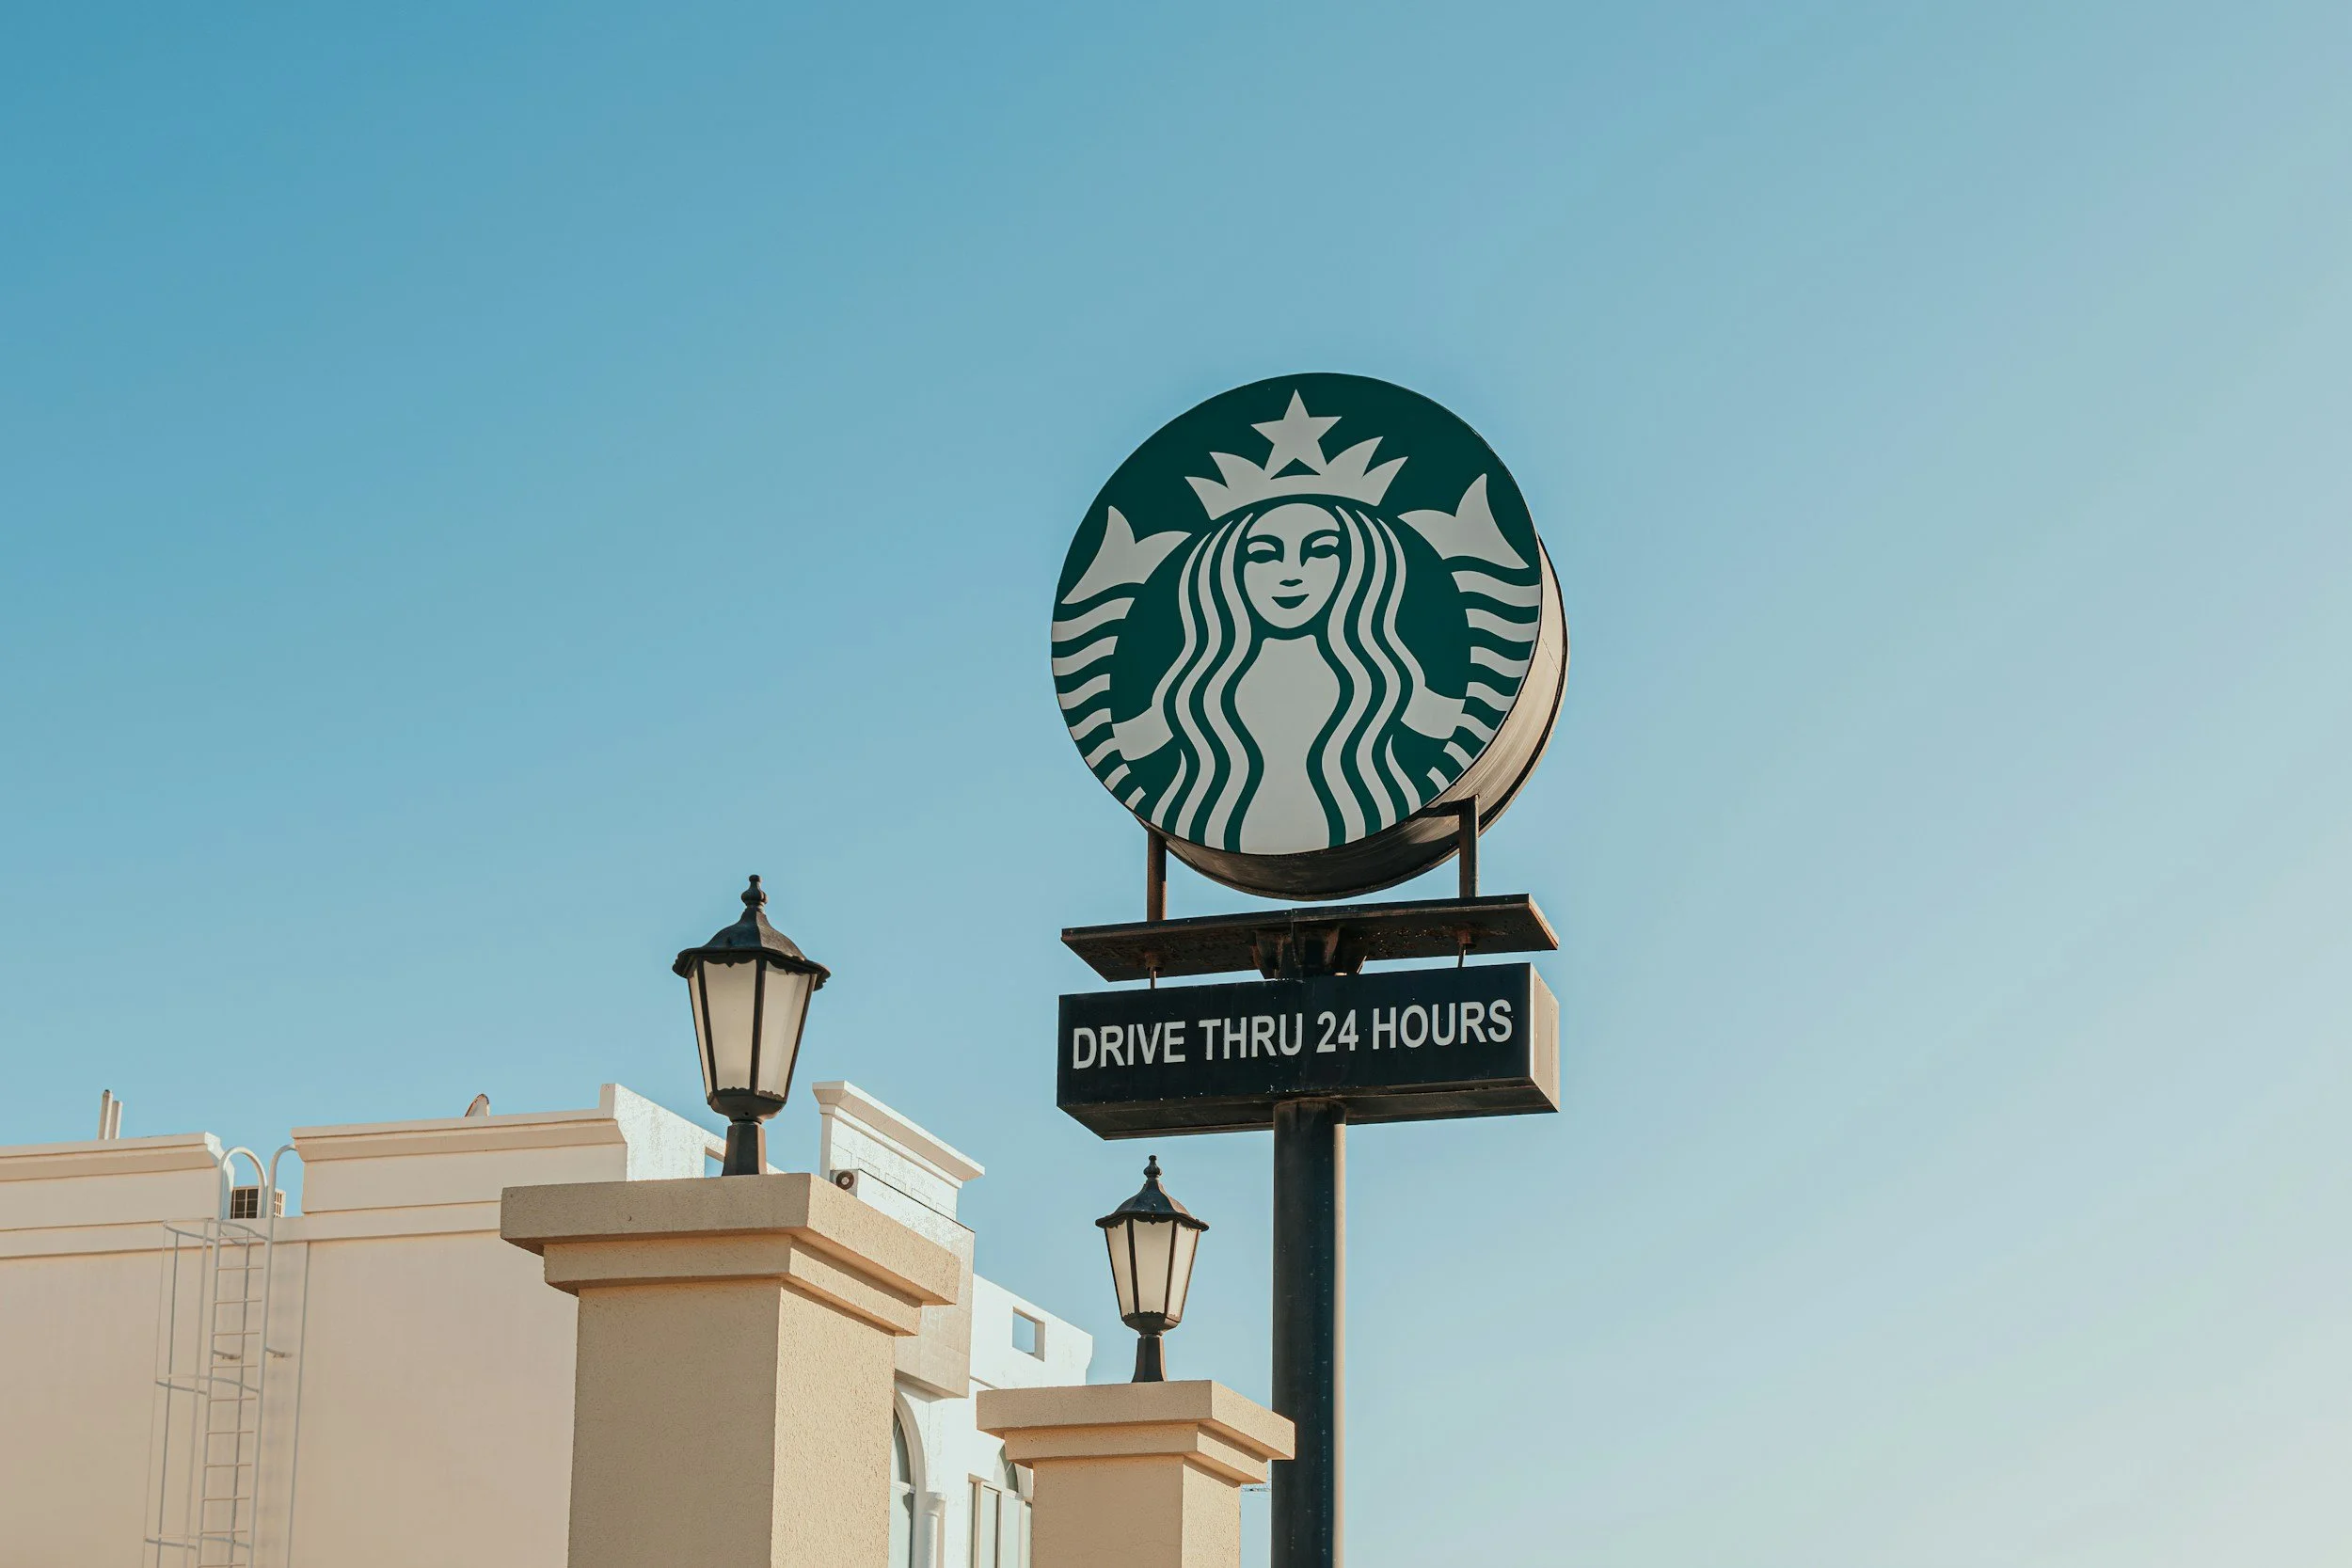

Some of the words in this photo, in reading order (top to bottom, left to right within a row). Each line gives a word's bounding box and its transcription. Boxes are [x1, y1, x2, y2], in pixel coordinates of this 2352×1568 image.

[1072, 1021, 1187, 1070] DRIVE
[1198, 1012, 1304, 1062] THRU
[1315, 1009, 1360, 1053] 24
[1372, 999, 1514, 1050] HOURS
